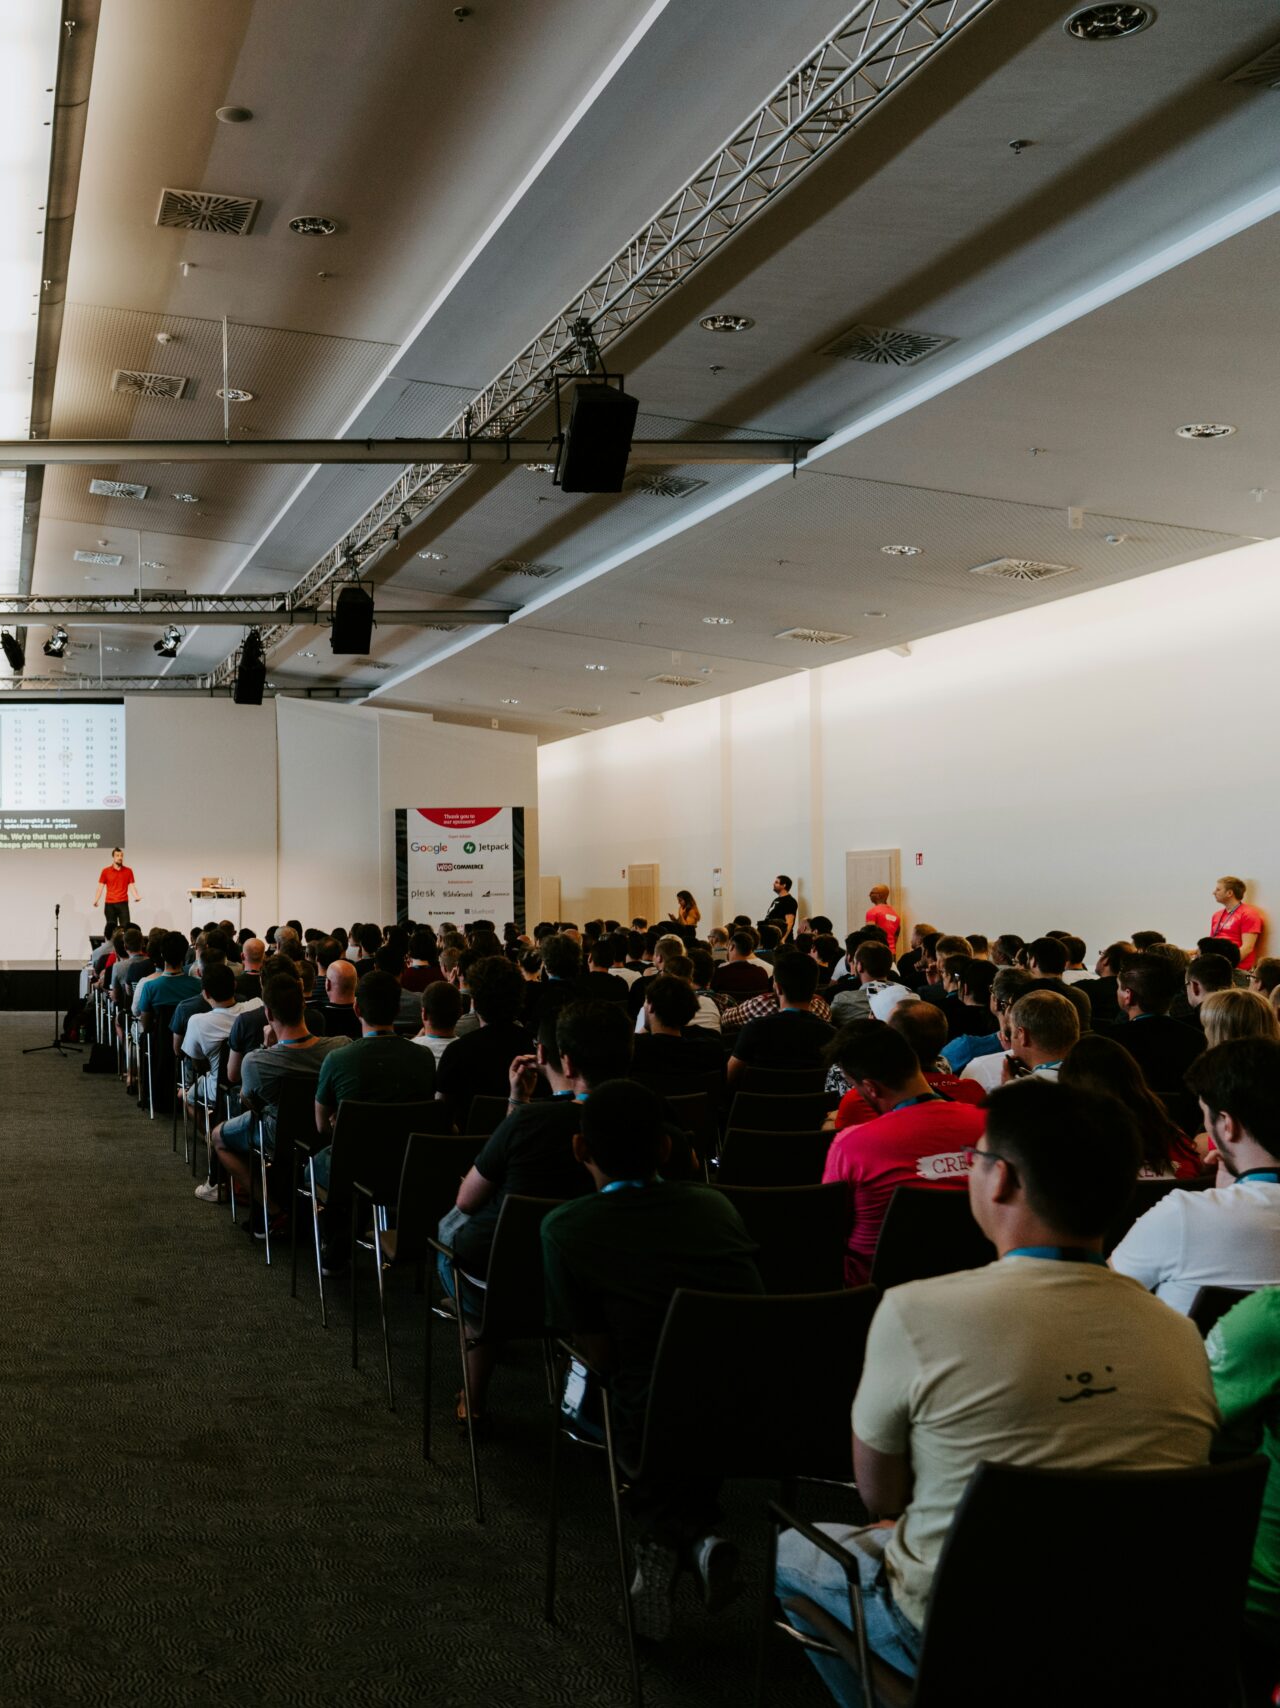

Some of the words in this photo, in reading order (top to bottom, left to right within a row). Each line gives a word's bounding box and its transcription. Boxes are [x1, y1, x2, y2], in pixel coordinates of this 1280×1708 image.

[410, 842, 448, 855] Google
[479, 843, 509, 853] Jetpack
[411, 889, 435, 898] plesk
[932, 1156, 970, 1174] CRE
